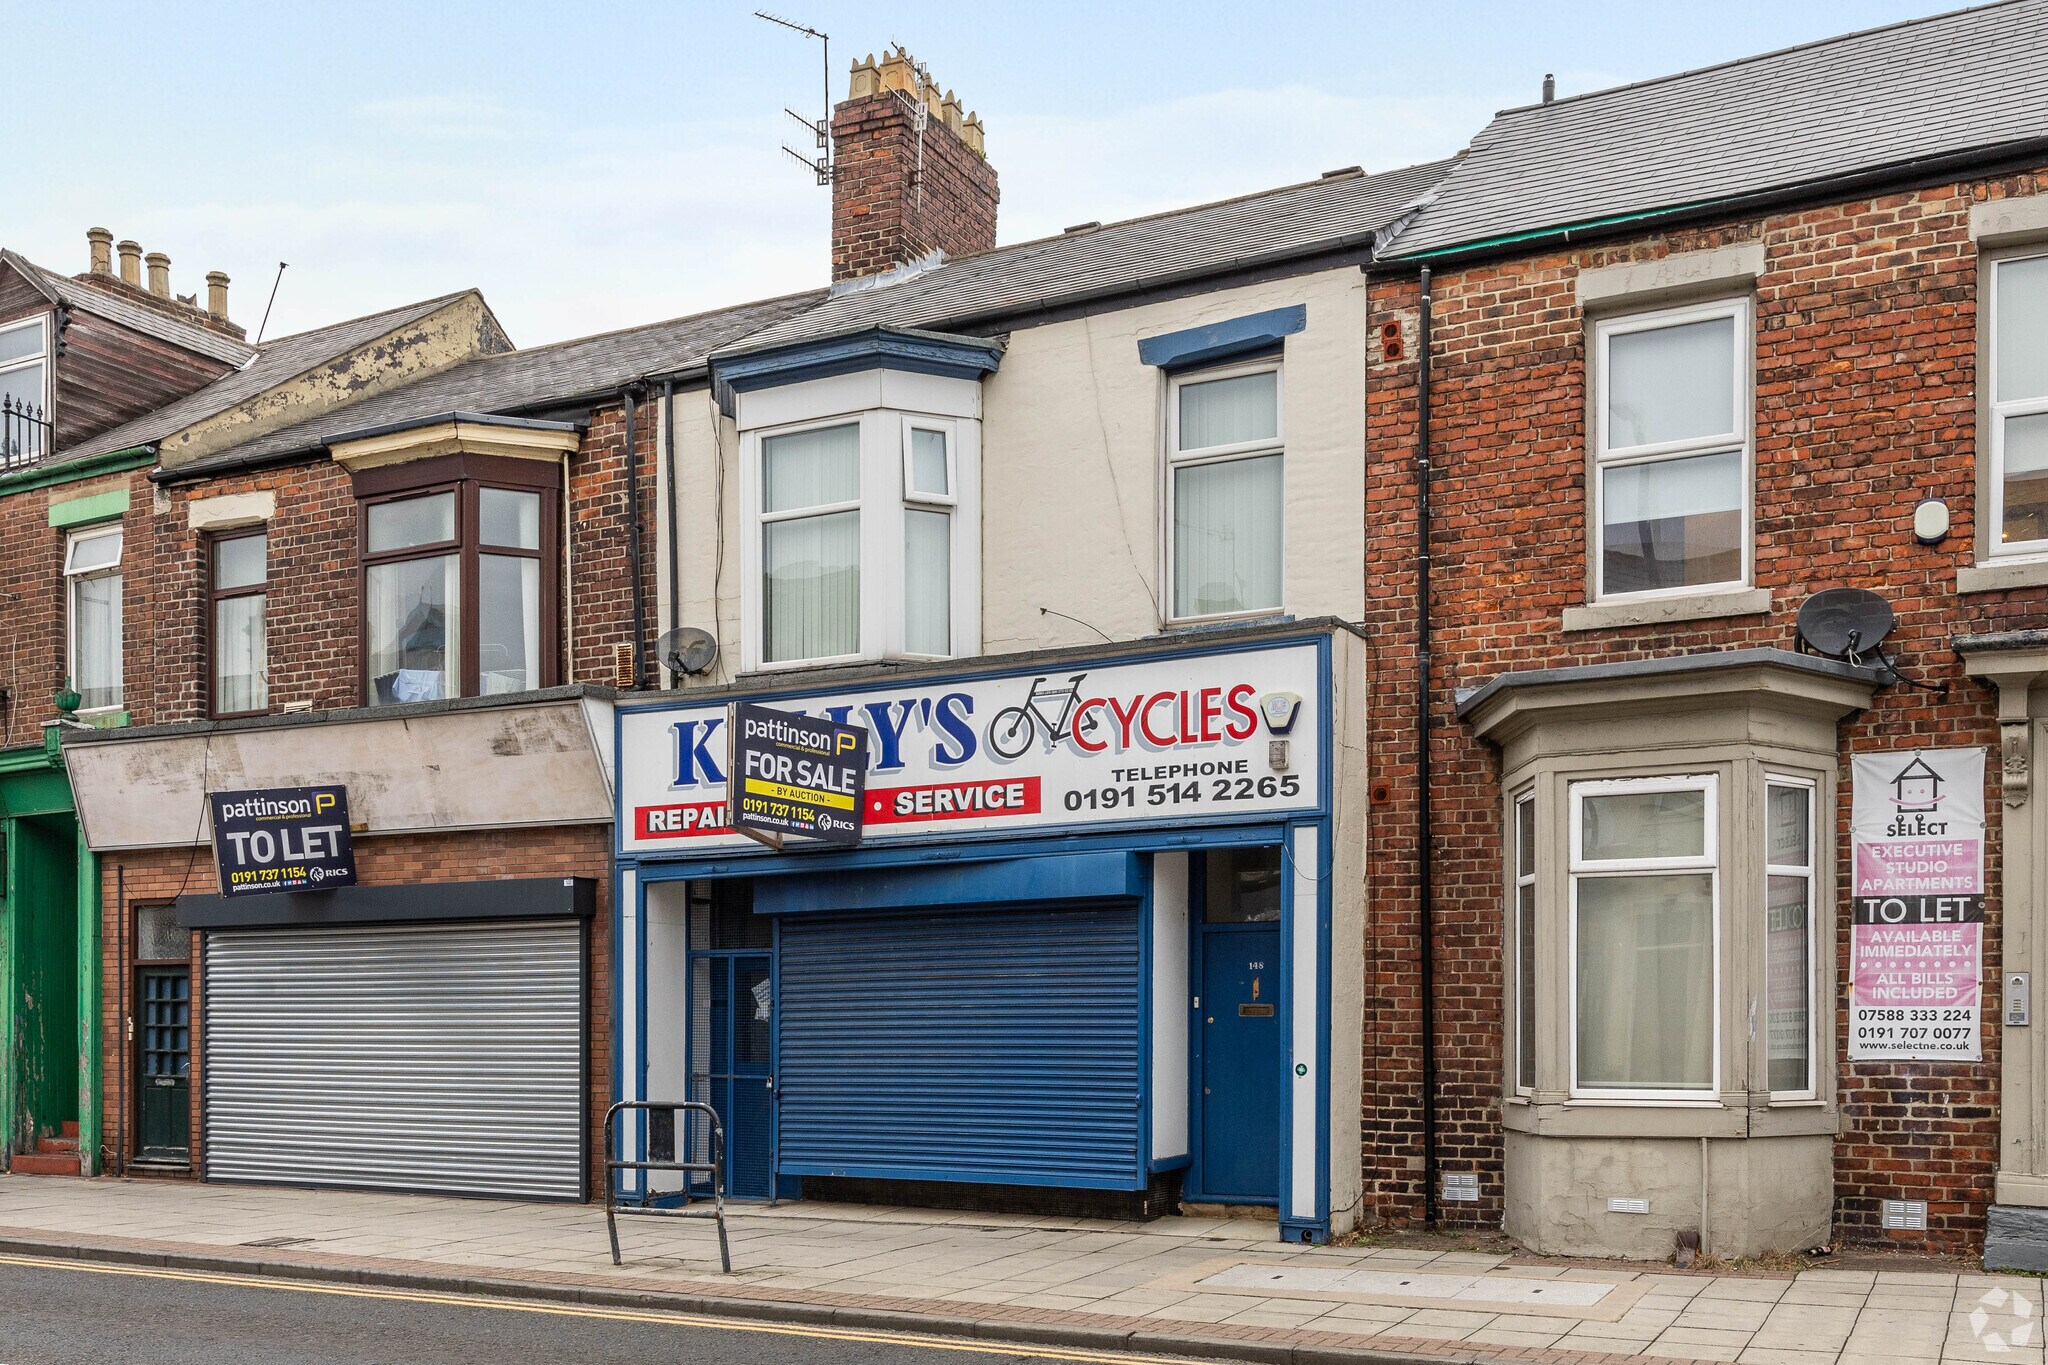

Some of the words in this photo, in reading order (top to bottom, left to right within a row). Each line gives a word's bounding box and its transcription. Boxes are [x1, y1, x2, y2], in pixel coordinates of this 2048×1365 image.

[672, 692, 977, 786] KY'S
[1072, 684, 1258, 752] CYCLES
[745, 719, 830, 750] pattinson
[745, 750, 792, 783] FOR
[796, 760, 856, 794] SALE
[1112, 760, 1248, 782] TELEPHONE
[776, 787, 788, 796] BY
[790, 788, 824, 802] AUCTION
[1064, 786, 1134, 811] 0191
[1148, 781, 1202, 806] 514
[1212, 774, 1300, 801] 2265
[222, 798, 311, 822] pattinson
[648, 805, 724, 832] REPAI
[895, 783, 1024, 816] SERVICE
[743, 798, 768, 813] 0191
[771, 803, 789, 816] 737
[792, 806, 815, 821] 1154
[743, 812, 789, 826] pattinson.co.uk
[833, 819, 854, 830] RICS
[1886, 815, 1948, 837] SELECT
[226, 830, 275, 865] TO
[280, 824, 342, 861] LET
[1872, 844, 1963, 858] EXECUTIVE
[231, 871, 257, 883] 0191
[260, 869, 279, 881] 737
[281, 867, 306, 879] 1154
[1886, 861, 1948, 873] STUDIO
[233, 880, 281, 892] pattinson.co.uk
[326, 868, 348, 876] RICS
[1861, 876, 1973, 891] APARTMENTS
[1863, 898, 1907, 923] TO
[1920, 897, 1971, 922] LET
[1871, 930, 1961, 942] AVAILABLE
[1860, 944, 1973, 958] IMMEDIATELY
[1249, 962, 1264, 970] 148
[1877, 973, 1907, 985] ALL
[1912, 972, 1953, 984] BILLS
[1872, 987, 1958, 1000] INCLUDED
[1858, 1009, 1904, 1021] 07588
[1910, 1009, 1938, 1021] 333
[1943, 1009, 1971, 1021] 224
[1858, 1027, 1894, 1038] 0191
[1901, 1027, 1928, 1038] 707
[1933, 1027, 1971, 1039] 0077
[1860, 1041, 1970, 1050] www.selectne.co.uk
